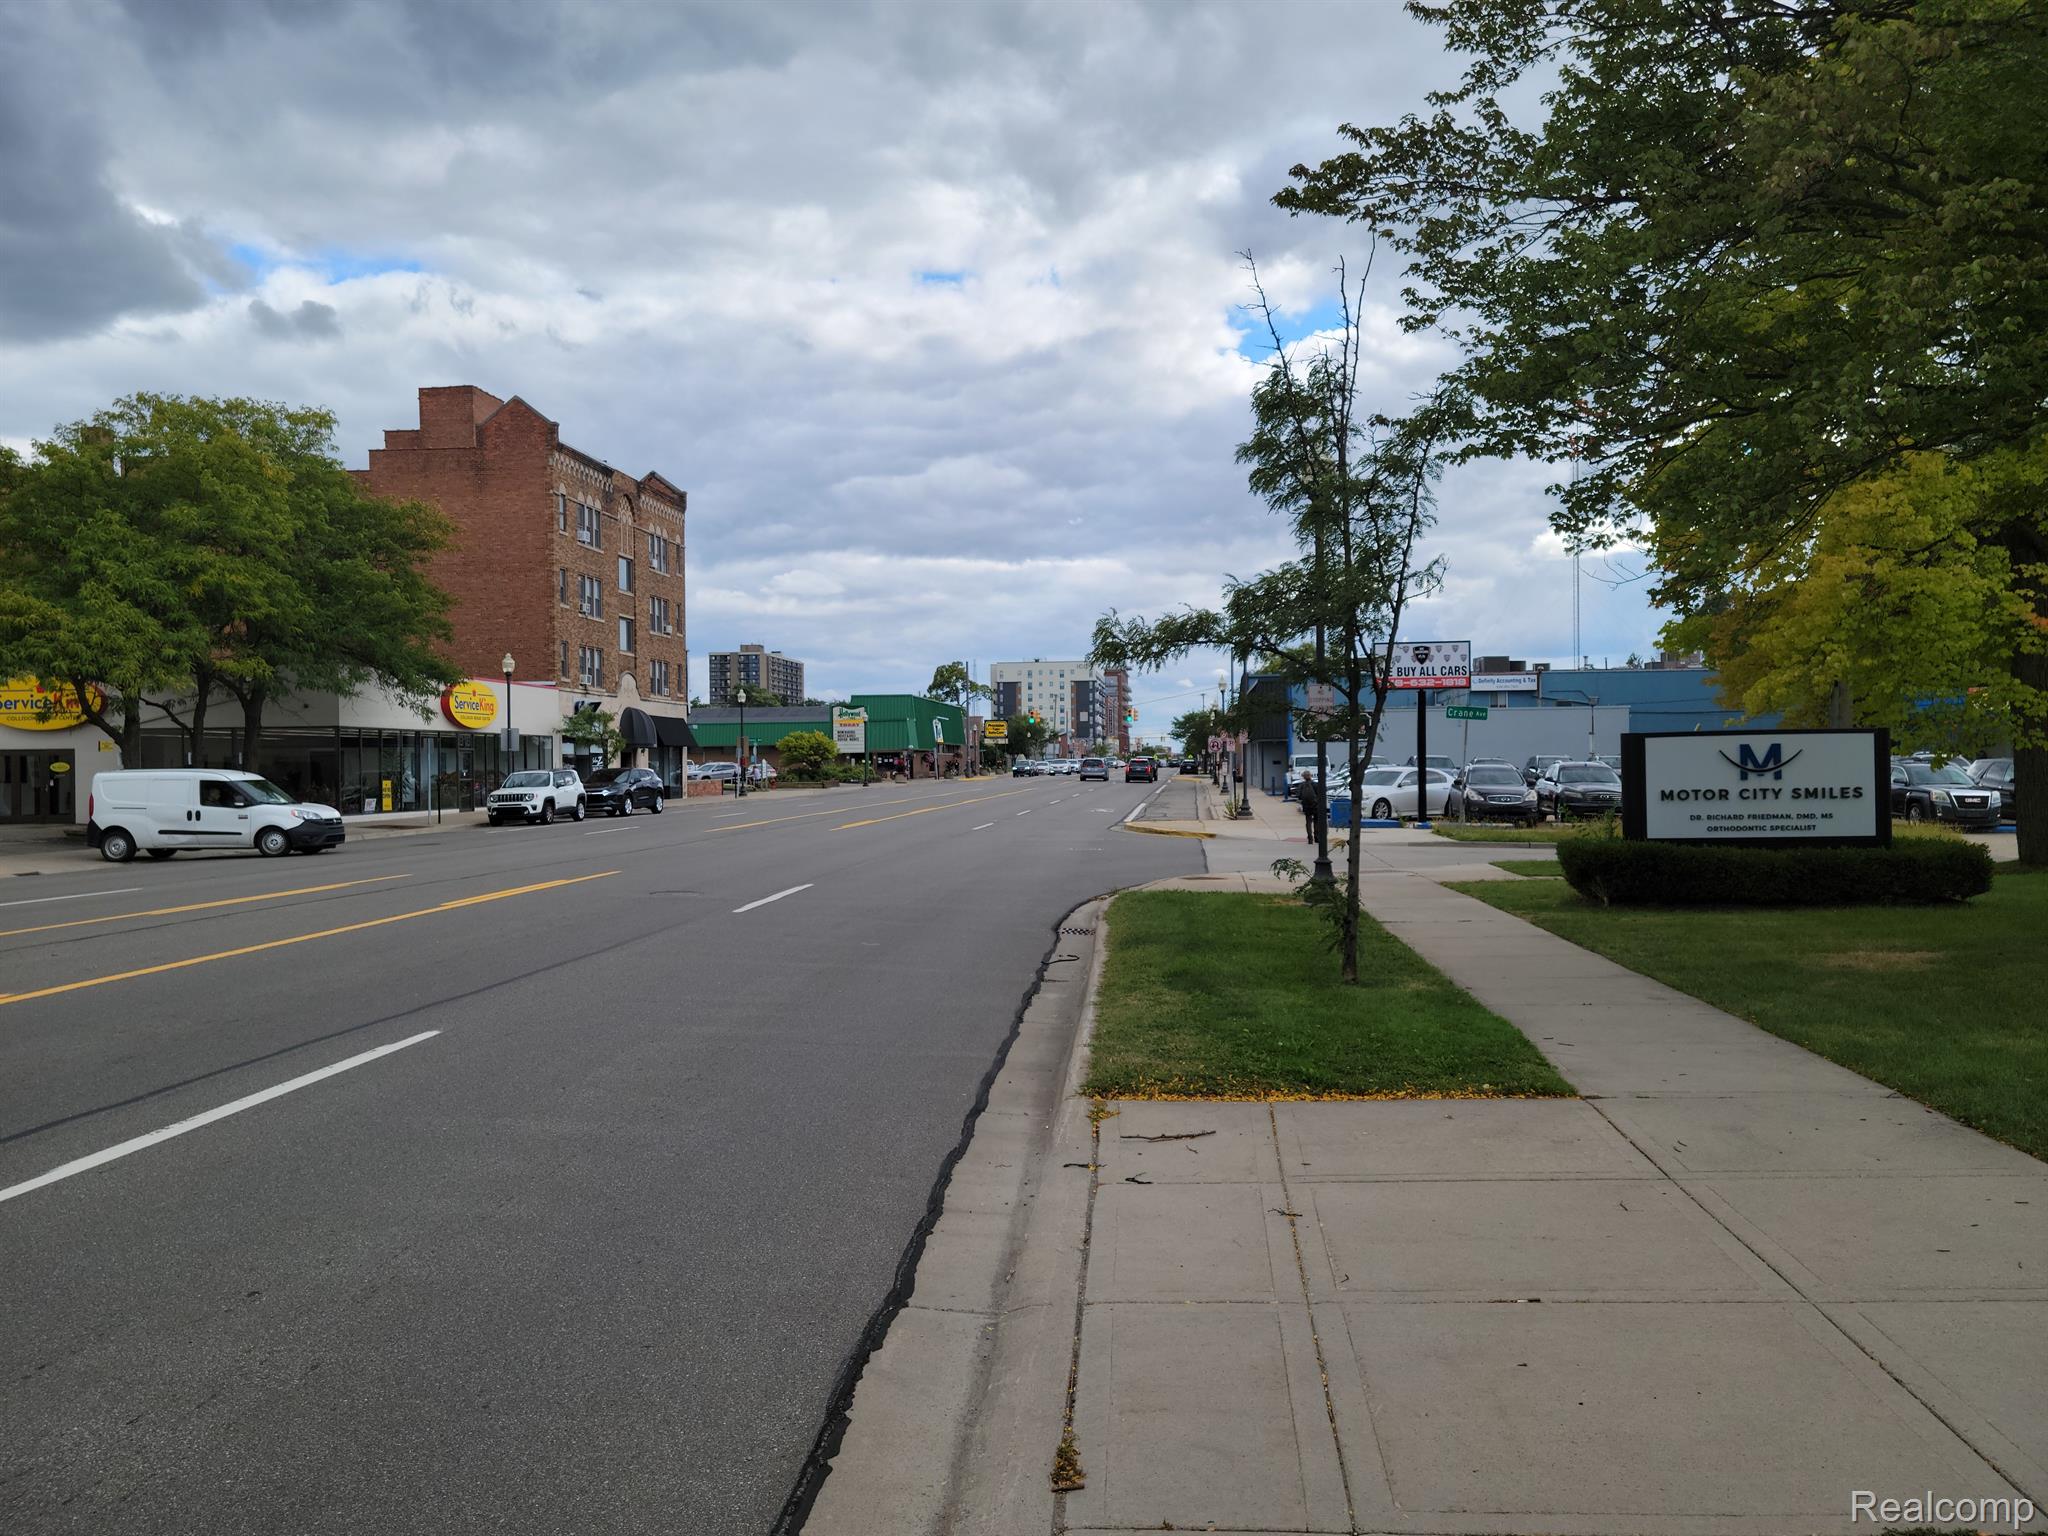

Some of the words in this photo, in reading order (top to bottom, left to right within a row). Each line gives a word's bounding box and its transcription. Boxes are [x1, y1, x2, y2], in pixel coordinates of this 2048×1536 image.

[1396, 666, 1416, 677] BUY
[1419, 666, 1437, 677] ALL
[1440, 665, 1467, 676] CARS
[1496, 677, 1522, 685] Accounting
[1447, 707, 1474, 718] Crane
[1660, 788, 1730, 801] MOTOR
[1738, 787, 1782, 800] CITY
[1791, 786, 1863, 800] SMILES
[1747, 813, 1794, 821] FRIEDMAN,
[1769, 824, 1817, 832] SPECIALIST
